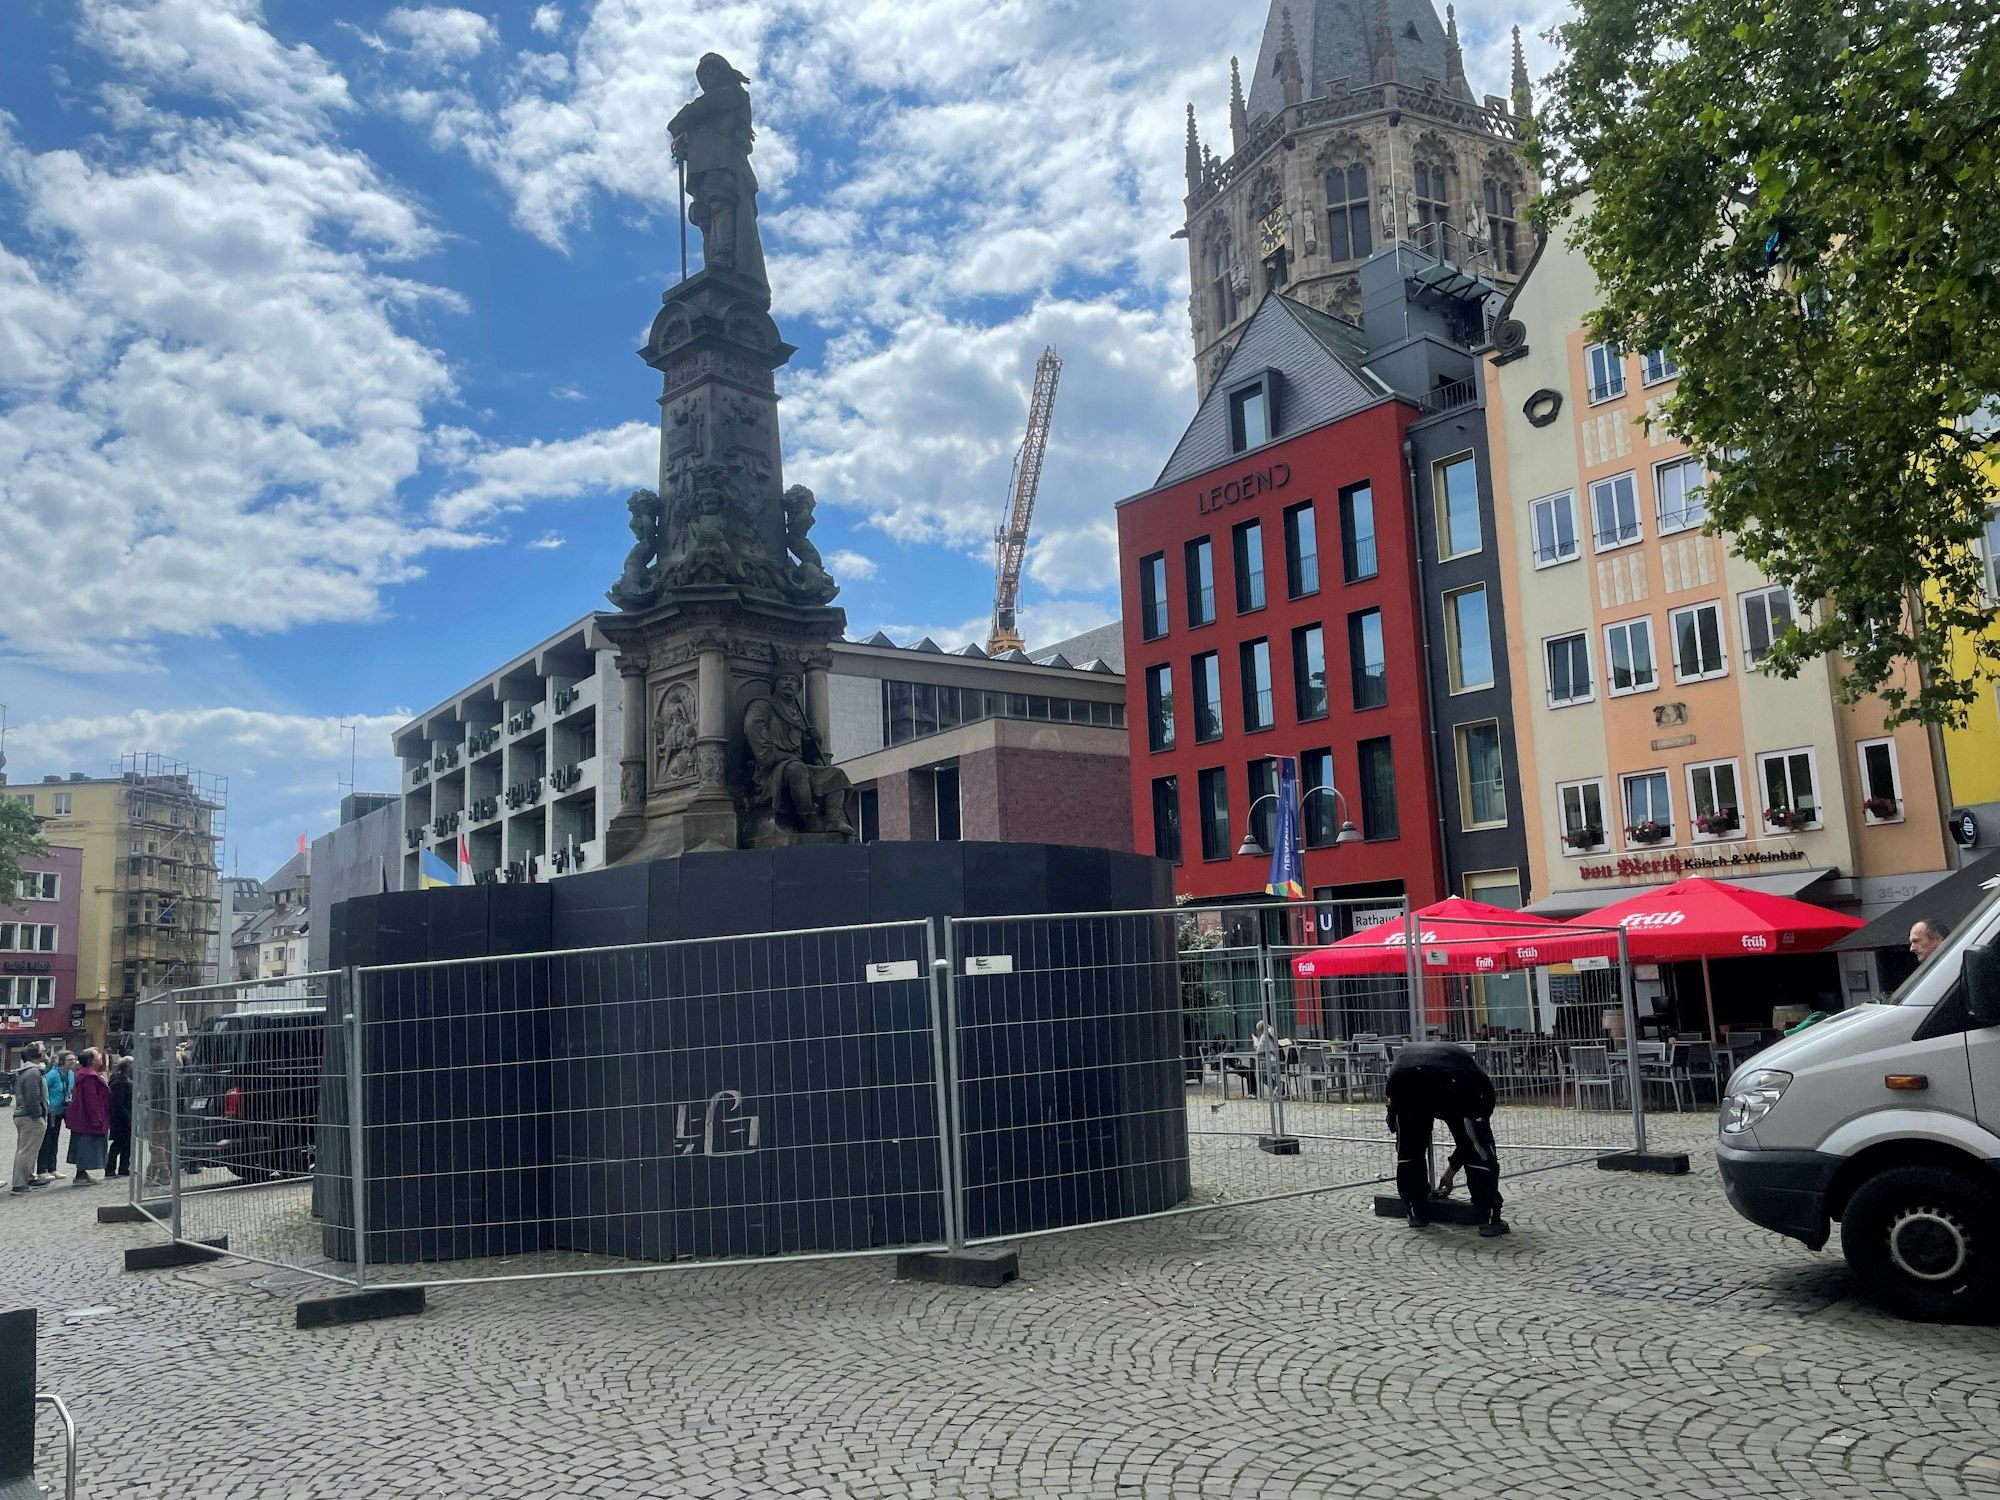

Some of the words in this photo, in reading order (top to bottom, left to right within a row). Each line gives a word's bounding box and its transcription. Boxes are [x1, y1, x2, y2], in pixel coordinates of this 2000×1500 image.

[1200, 463, 1290, 515] LEGEND
[1580, 865, 1612, 880] von
[1684, 856, 1727, 870] Kölsch
[1731, 854, 1743, 866] &
[1745, 850, 1804, 864] Weinbar
[1879, 886, 1918, 898] 35-37
[1320, 914, 1332, 931] U
[1619, 911, 1685, 926] früh
[1741, 935, 1766, 948] früh
[1516, 947, 1538, 958] früh
[1298, 962, 1315, 972] früh
[1475, 956, 1494, 968] früh
[23, 1009, 32, 1018] U
